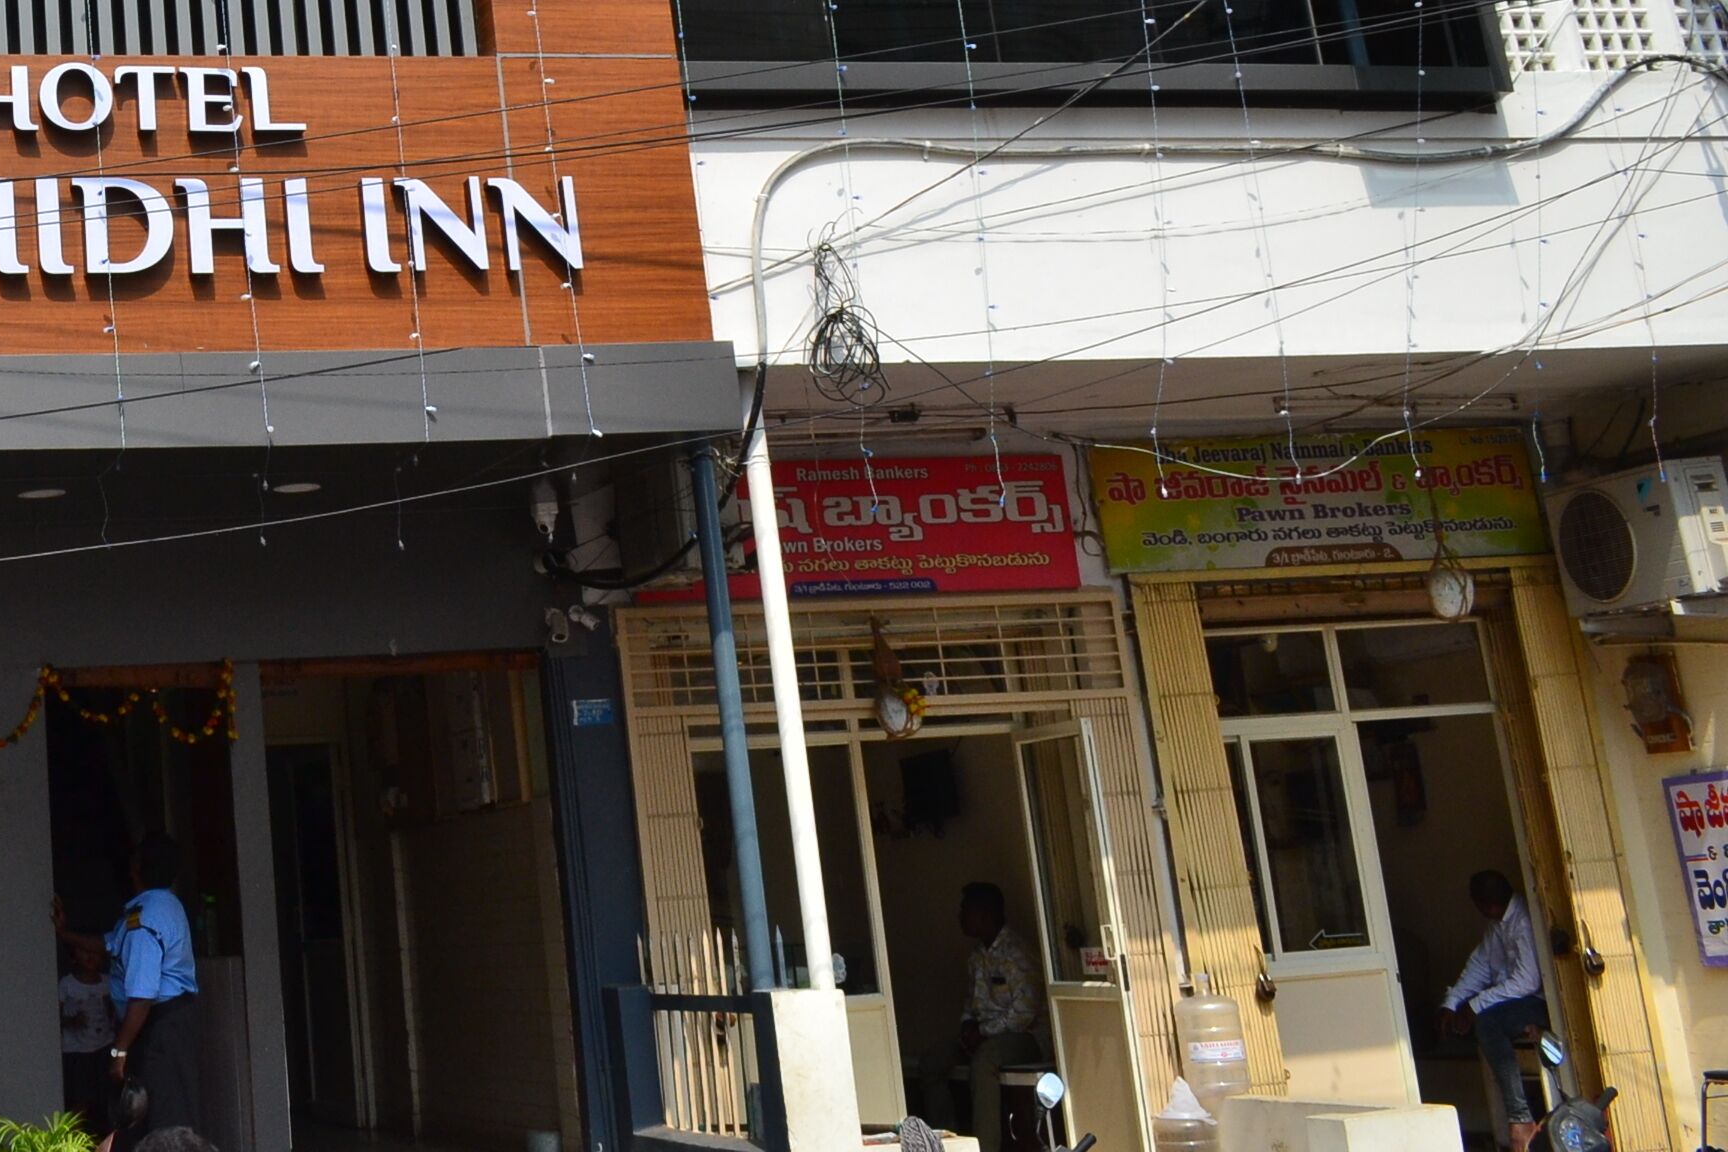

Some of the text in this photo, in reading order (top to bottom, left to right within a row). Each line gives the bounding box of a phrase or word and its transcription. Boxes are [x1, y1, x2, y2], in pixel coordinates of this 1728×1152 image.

[361, 176, 584, 272] INN
[1193, 443, 1267, 463] Jeevaraj
[1362, 438, 1433, 456] Bankers
[796, 465, 929, 481] Ramesh Bankers
[1106, 472, 1146, 505] షా
[1392, 474, 1406, 489] &
[823, 481, 1065, 541] బ్యాంకర్స్
[1236, 502, 1412, 523] Pawn Brokers
[1198, 529, 1268, 545] బంగారు
[1273, 526, 1322, 541] నగలు
[1326, 522, 1384, 543] తాకట్టు
[783, 537, 882, 554] wn Brokers
[798, 558, 849, 572] నగలు
[854, 556, 913, 575] తాకట్టు
[1676, 791, 1705, 838] షా
[1707, 846, 1718, 861] &
